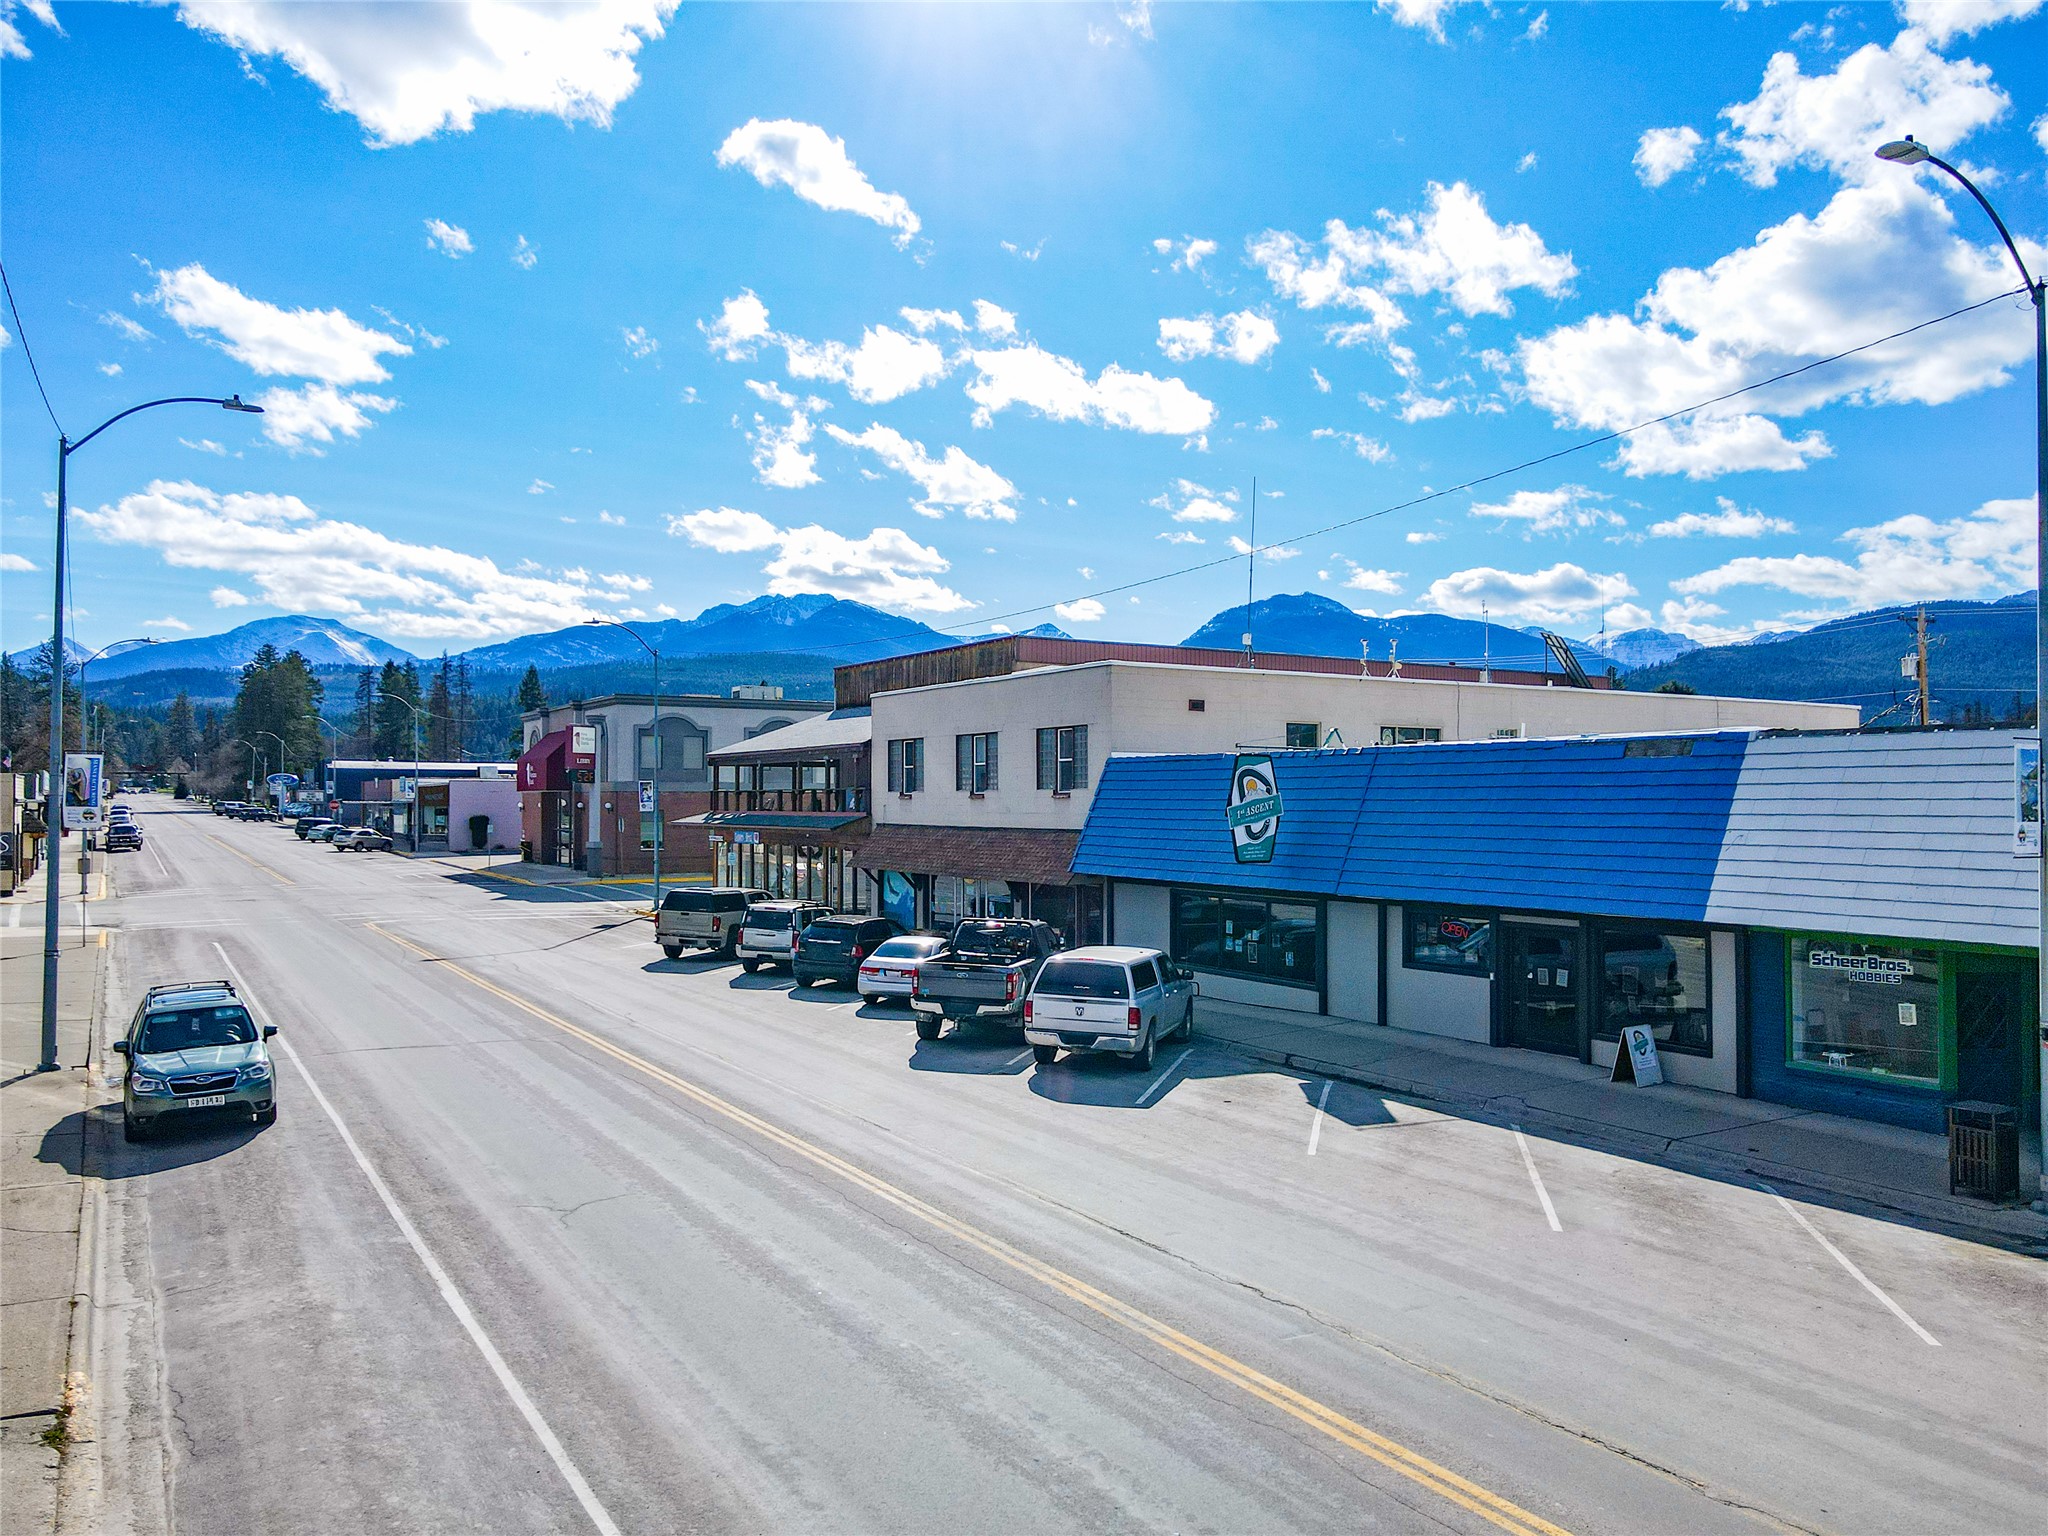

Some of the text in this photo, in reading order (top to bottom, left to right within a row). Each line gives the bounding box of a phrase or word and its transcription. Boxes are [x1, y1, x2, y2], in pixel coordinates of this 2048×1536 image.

[1245, 800, 1275, 817] ASCENT
[1441, 921, 1469, 939] OPEN
[1848, 970, 1902, 984] HOBBIES
